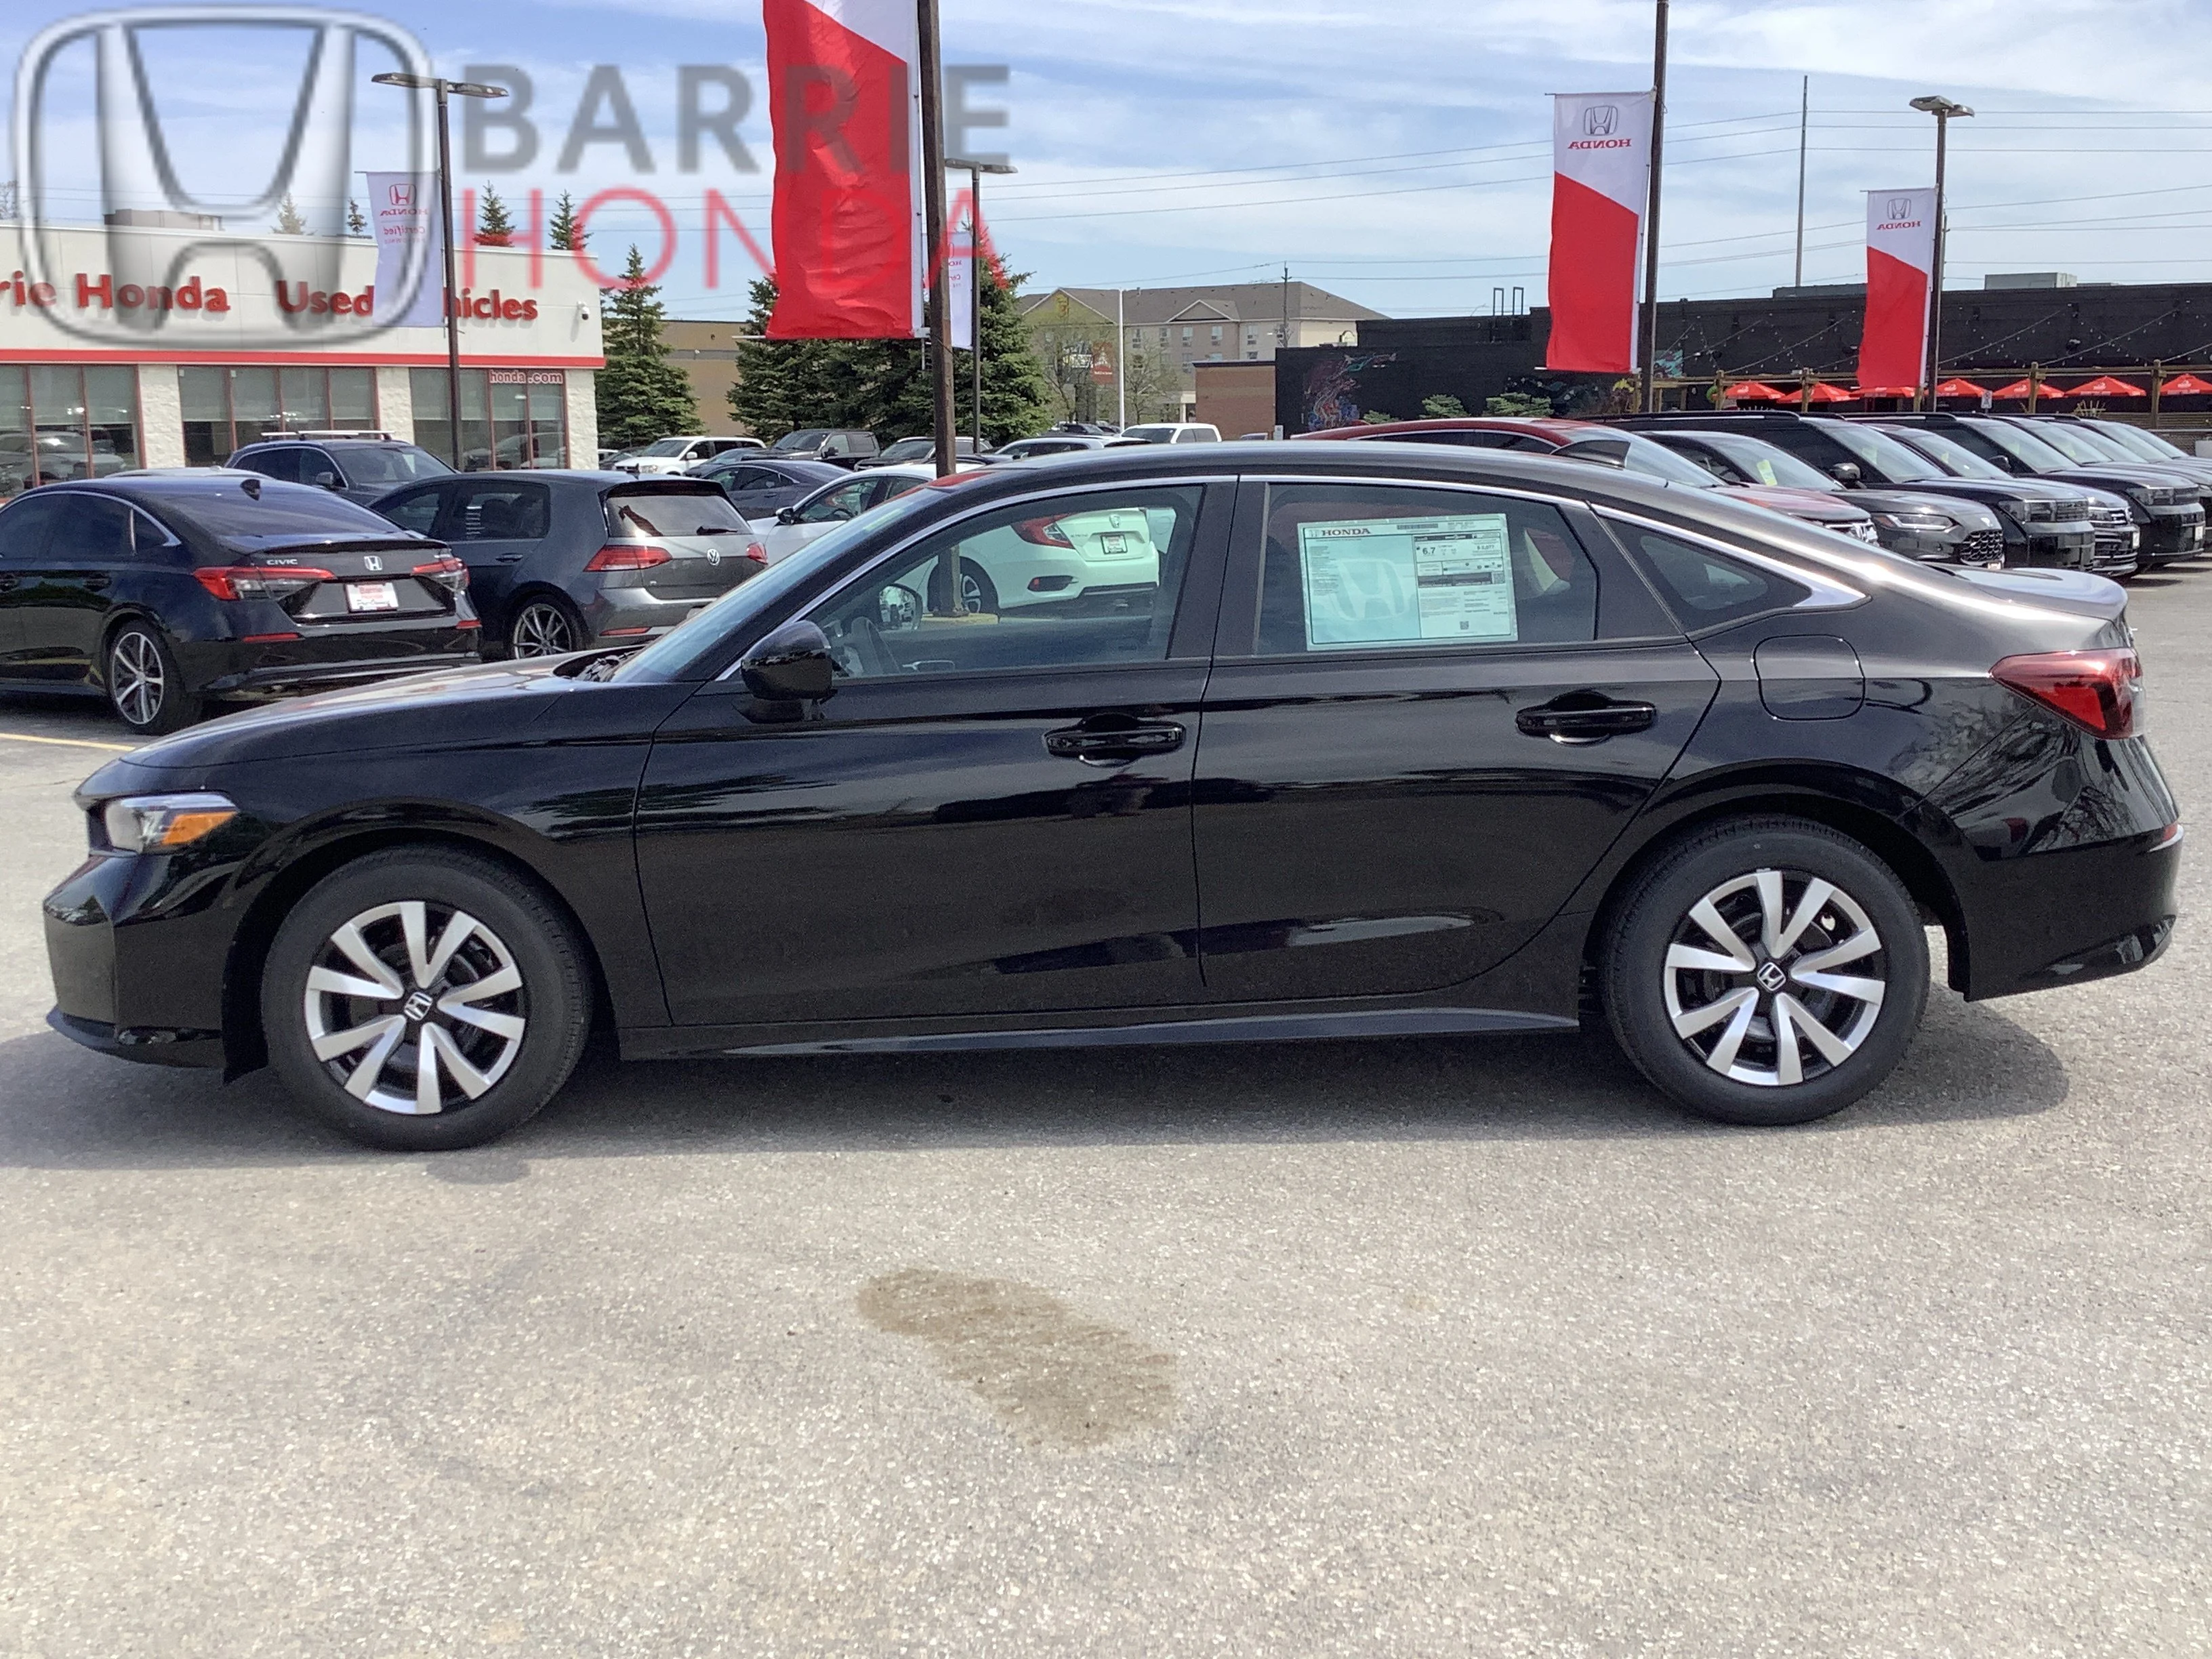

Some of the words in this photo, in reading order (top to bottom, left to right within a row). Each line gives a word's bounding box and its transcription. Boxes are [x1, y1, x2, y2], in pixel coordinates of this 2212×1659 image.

[75, 272, 231, 313] Honda
[276, 280, 374, 316] Used
[1422, 547, 1436, 555] 6.7
